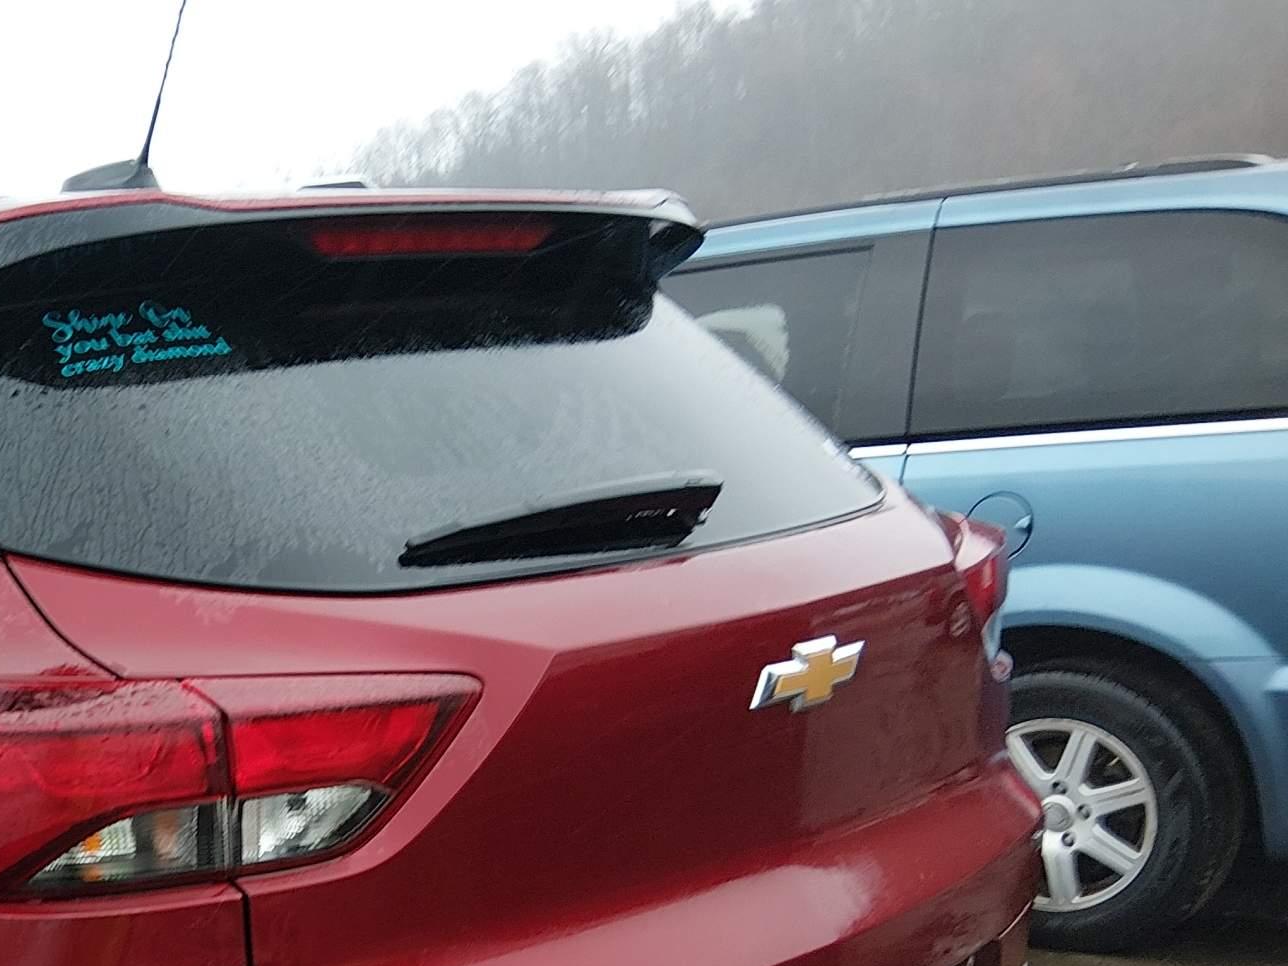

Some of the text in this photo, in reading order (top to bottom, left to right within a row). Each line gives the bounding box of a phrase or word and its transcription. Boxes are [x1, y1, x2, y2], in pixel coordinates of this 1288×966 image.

[42, 309, 133, 343] Shine
[53, 337, 109, 363] you
[61, 353, 125, 378] crazy
